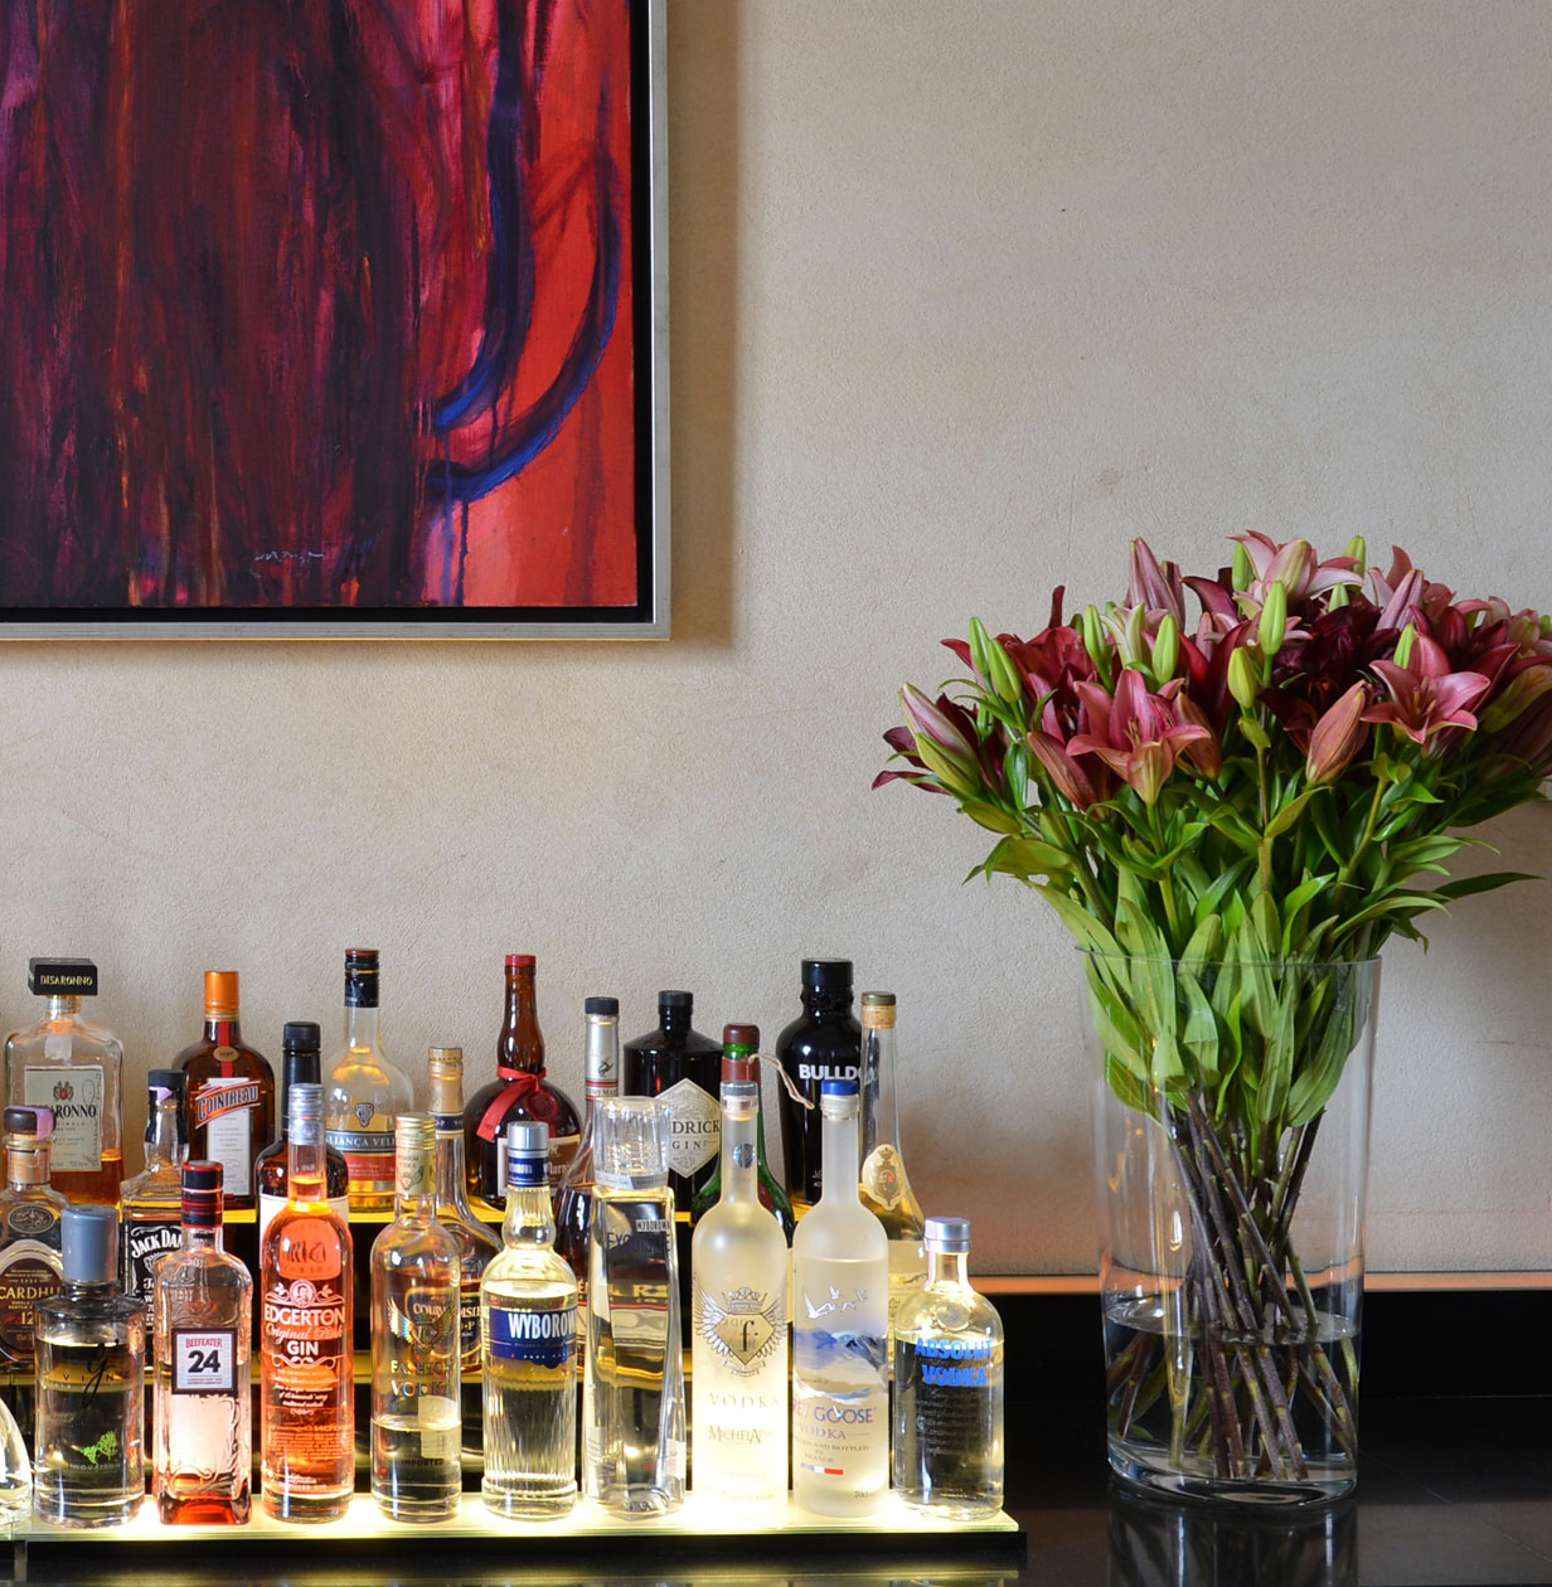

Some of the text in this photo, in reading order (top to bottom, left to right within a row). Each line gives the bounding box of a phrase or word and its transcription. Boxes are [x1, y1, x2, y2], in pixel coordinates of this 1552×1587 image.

[39, 975, 93, 986] DISARONNO
[798, 1063, 863, 1081] BULLD
[197, 1085, 259, 1120] COINTREAU
[672, 1121, 720, 1135] DRICK
[672, 1140, 701, 1151] GIN
[130, 1234, 161, 1258] JACK
[21, 1311, 34, 1325] 12
[264, 1303, 345, 1326] EDGERTON
[265, 1322, 311, 1345] Original
[508, 1311, 576, 1339] WYBOROW
[185, 1338, 222, 1348] BEEFEATER
[287, 1341, 319, 1355] GIN
[188, 1349, 221, 1373] 24
[814, 1406, 874, 1424] GOOSE
